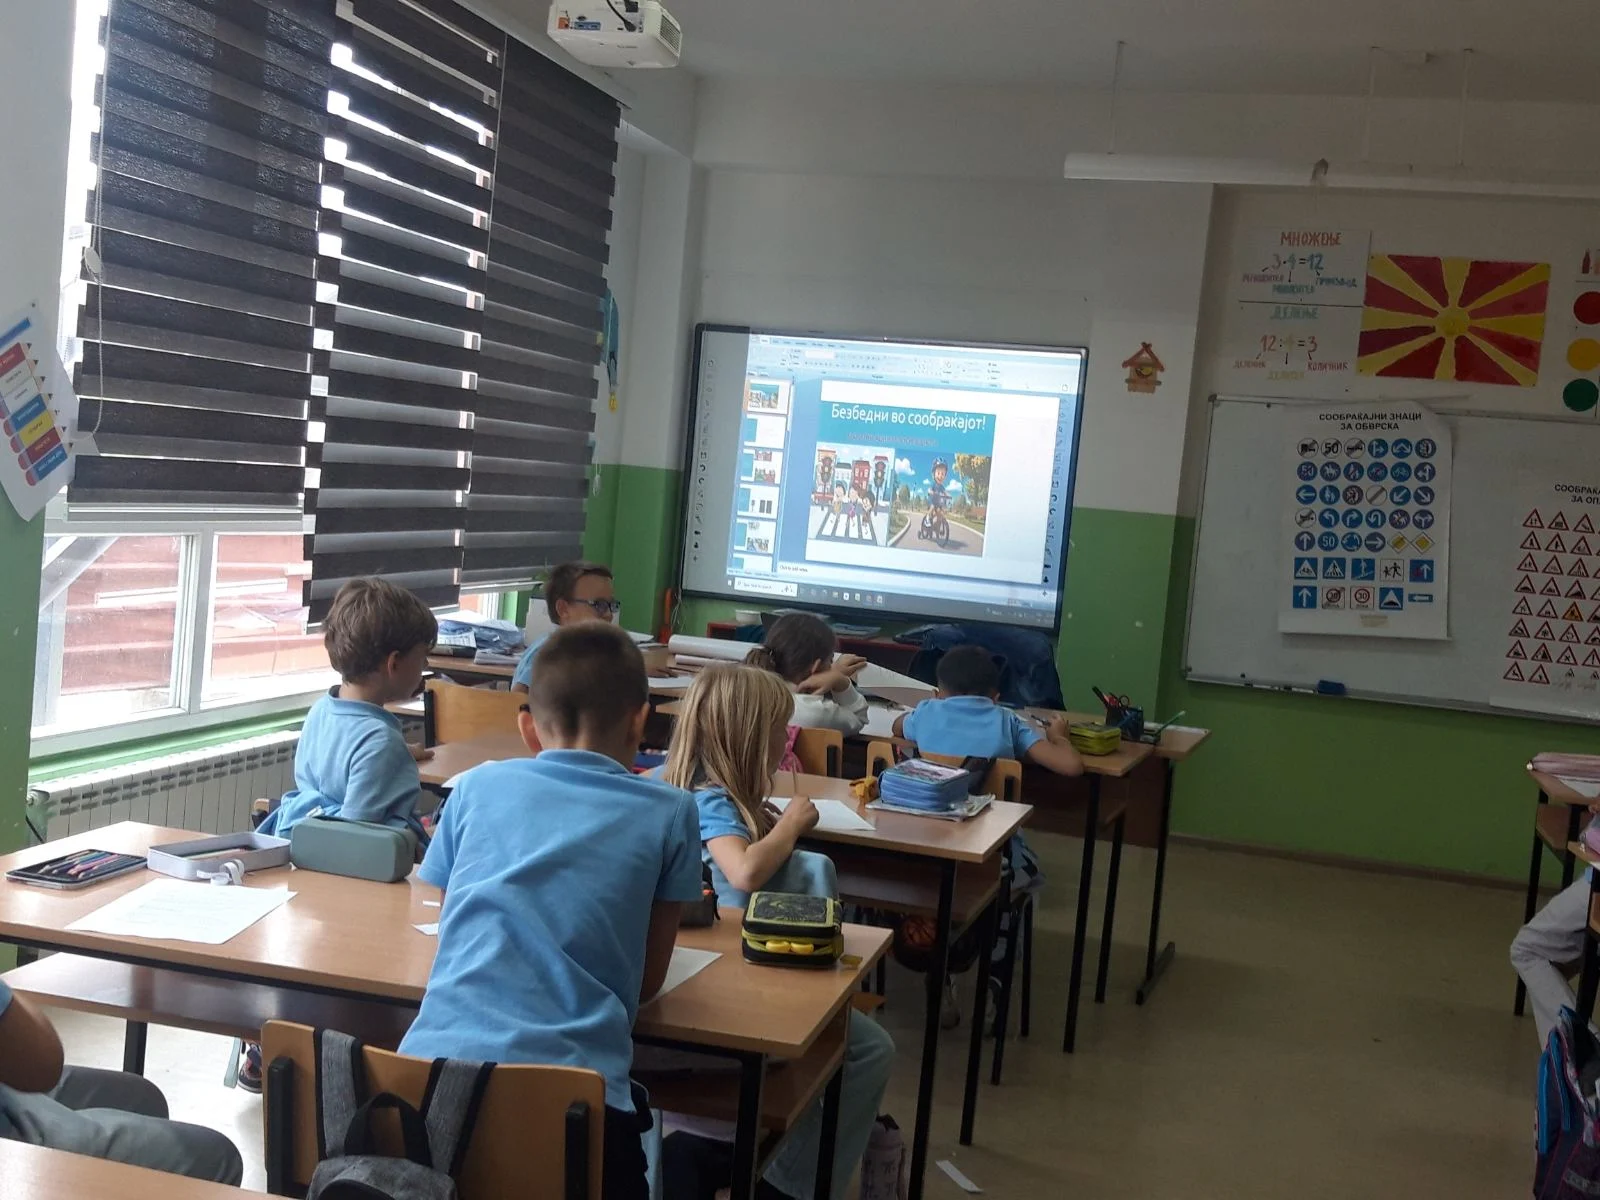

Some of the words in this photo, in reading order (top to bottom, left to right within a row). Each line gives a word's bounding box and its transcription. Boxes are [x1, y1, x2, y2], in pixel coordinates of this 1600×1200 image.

[1280, 231, 1342, 247] МНОЖЕЊЕ
[831, 403, 889, 425] Безбедни
[891, 411, 906, 424] во
[908, 411, 986, 434] сообраќајот!
[1319, 411, 1388, 421] СООБРАЌАЈНИ
[1389, 412, 1422, 421] ЗНАЦИ
[1340, 422, 1353, 430] ЗА
[1355, 422, 1400, 430] ОБВРСКА
[1585, 496, 1600, 505] ОП
[1322, 537, 1335, 546] 50
